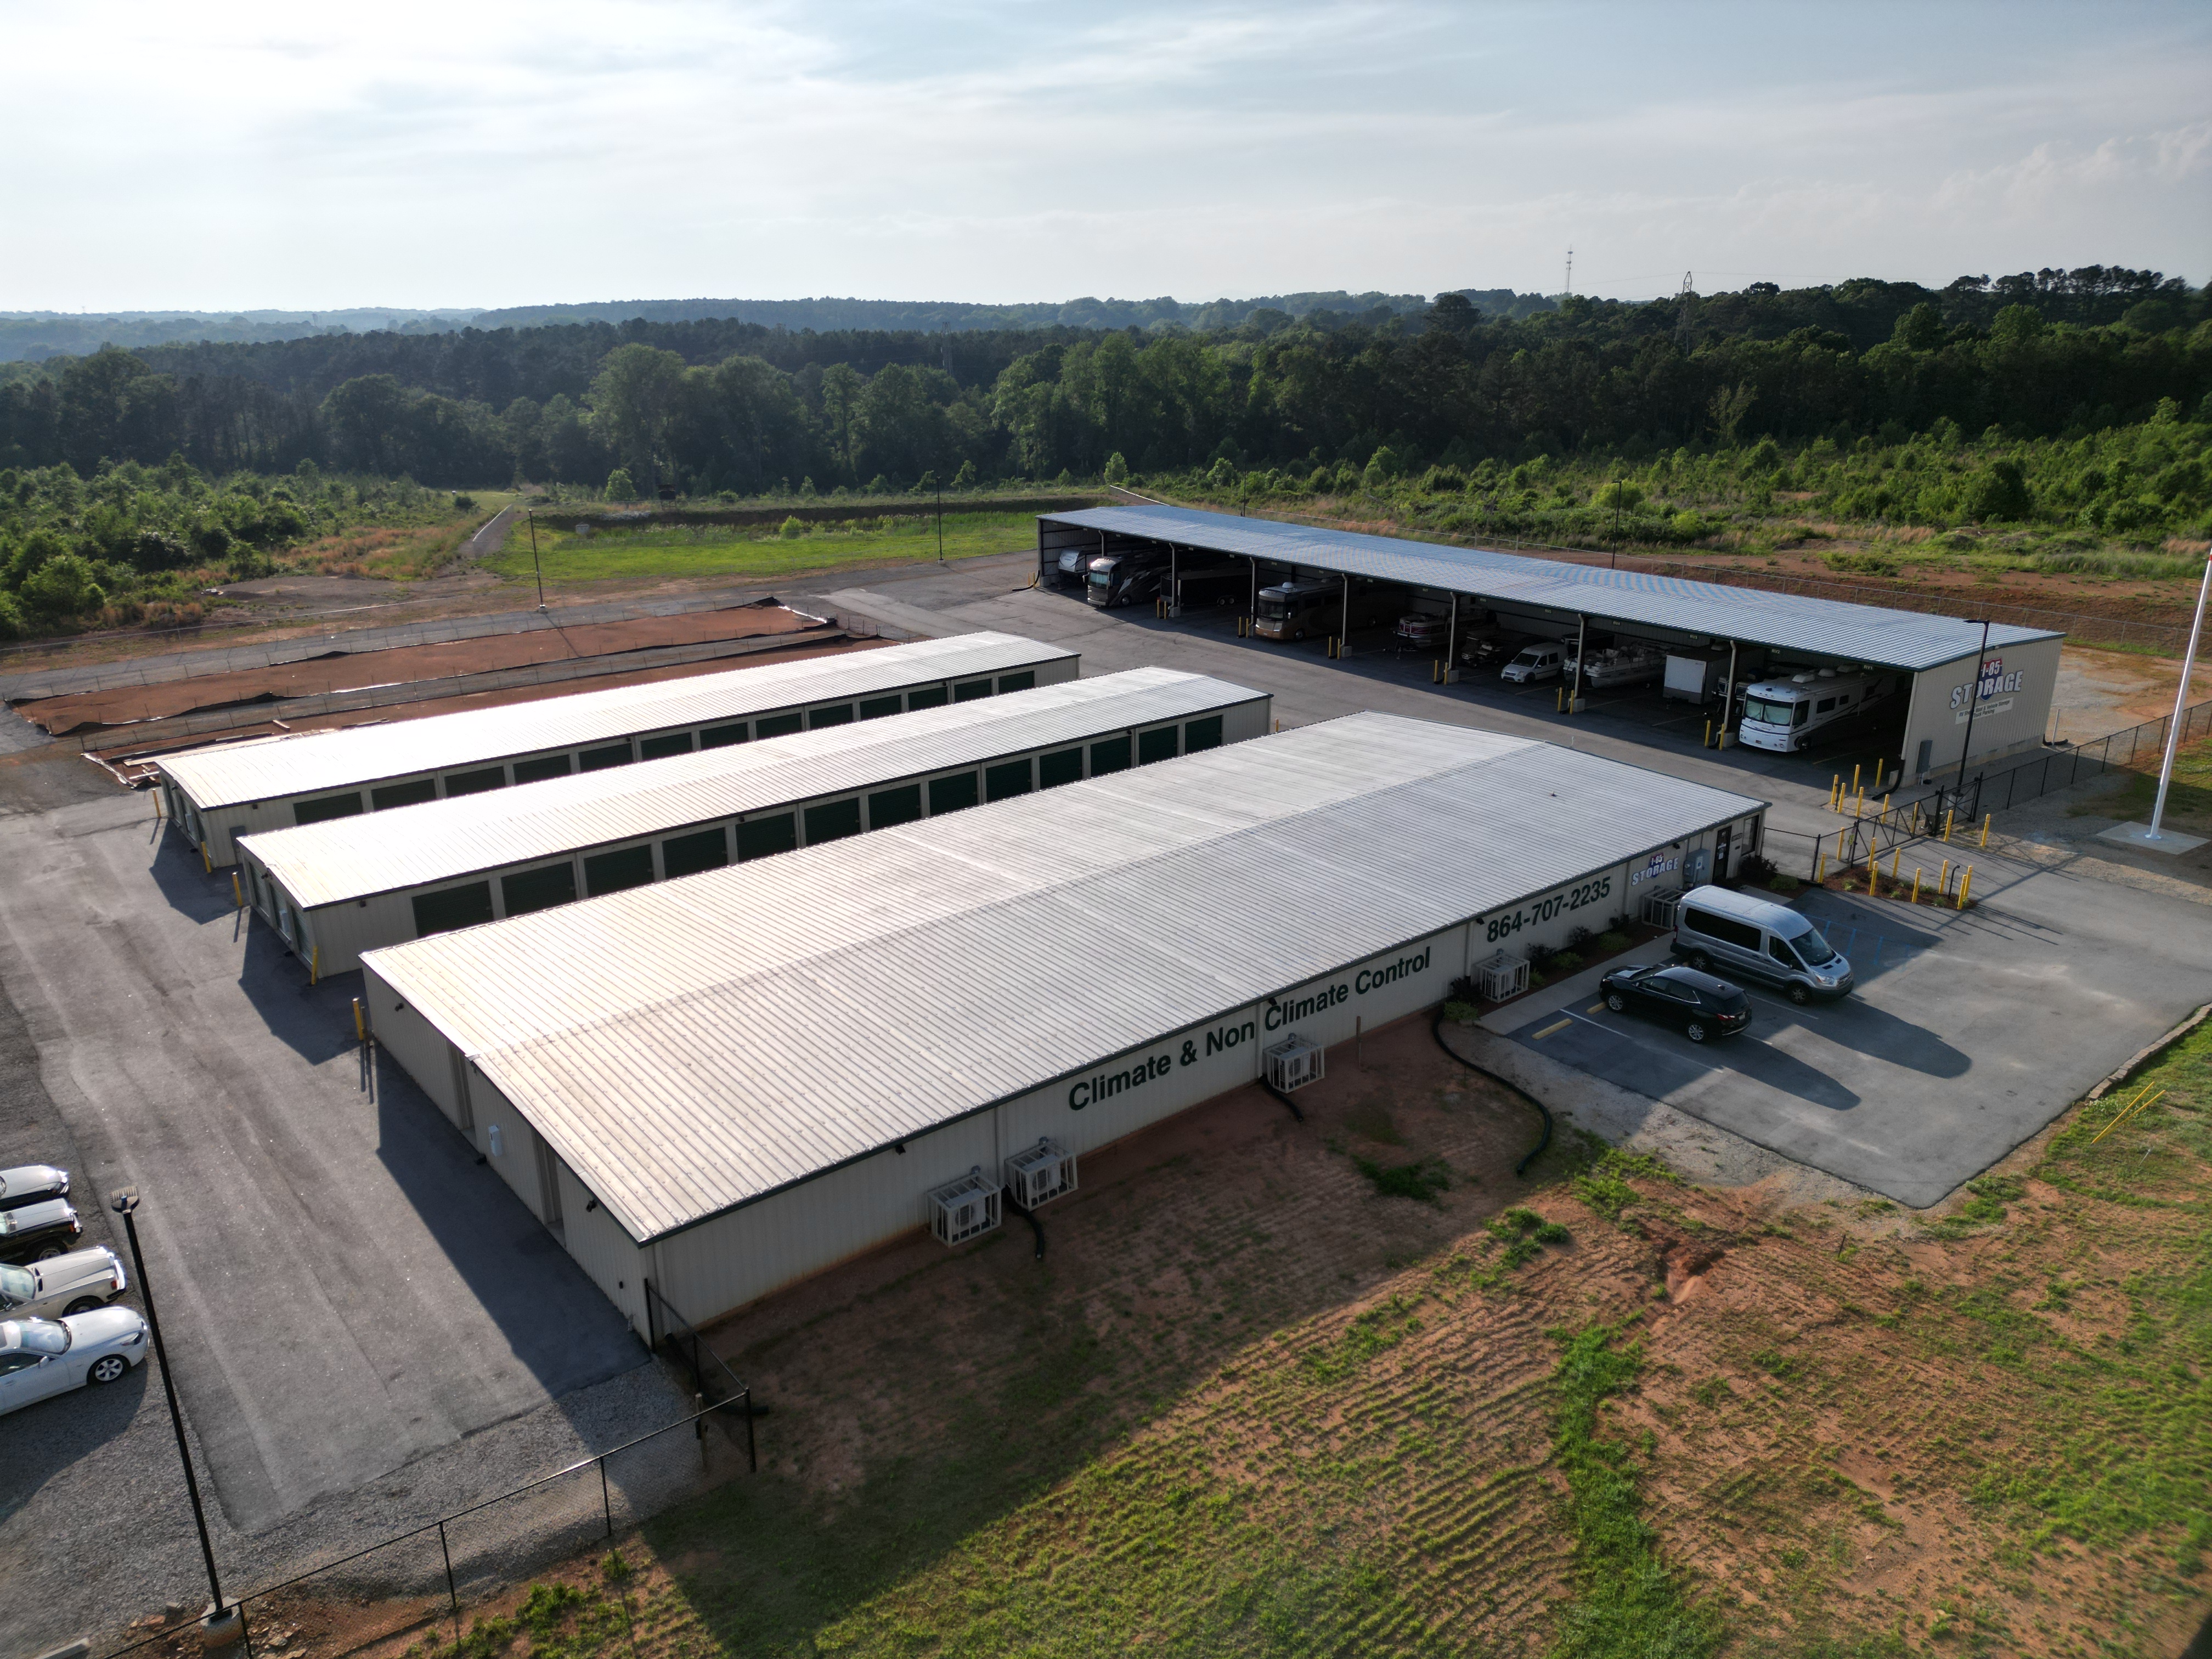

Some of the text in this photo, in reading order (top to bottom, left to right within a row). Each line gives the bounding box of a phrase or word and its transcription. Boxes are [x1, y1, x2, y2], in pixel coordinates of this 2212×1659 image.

[1982, 660, 2001, 678] I-85
[1632, 857, 1679, 886] STORAGE
[1651, 854, 1663, 866] I-85
[1487, 876, 1611, 943] 864-707-2235
[1069, 946, 1430, 1111] Climate & Non Climate Control
